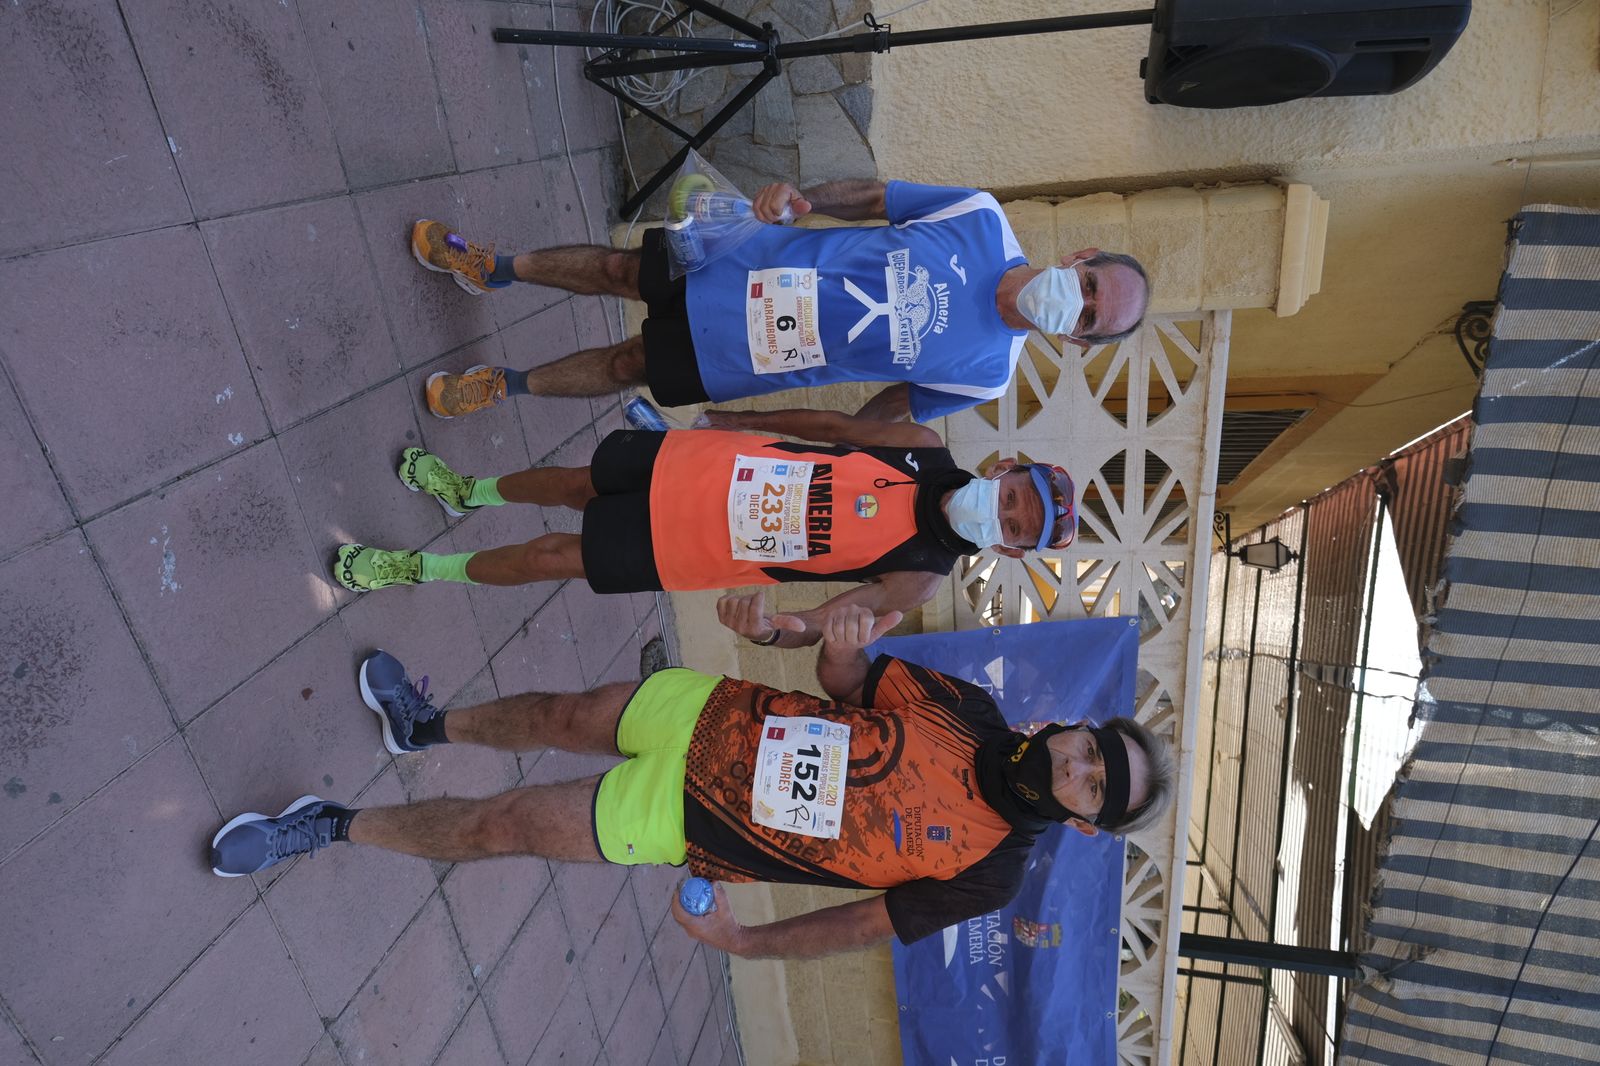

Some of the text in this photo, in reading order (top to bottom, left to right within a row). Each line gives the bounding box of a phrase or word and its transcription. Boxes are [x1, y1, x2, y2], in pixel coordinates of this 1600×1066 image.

[796, 296, 804, 320] CARRERAS
[804, 296, 813, 328] CIRCUITO
[891, 252, 912, 362] GUEPARDOS RUNNIG
[764, 298, 778, 354] BARAMBONES
[776, 315, 796, 332] 6
[797, 321, 806, 348] POPULARES
[804, 329, 816, 347] 2020
[781, 348, 798, 362] R
[749, 494, 760, 520] DIEGO
[760, 482, 786, 532] 233
[784, 484, 794, 506] CARRERAS
[792, 483, 804, 514] CIRCUITO
[783, 506, 791, 535] POPULARES
[790, 515, 800, 535] 2020
[778, 752, 794, 792] ANDRÉS
[791, 744, 822, 802] 152
[820, 744, 830, 772] CARRERAS
[816, 773, 828, 805] POPULARES
[825, 745, 842, 806] CIRCUITO 2020
[785, 804, 810, 824] R
[905, 808, 916, 856] DE ALMERÍA
[913, 806, 925, 857] DIPUTACIÓN
[968, 916, 987, 965] LMERÍA
[986, 909, 1005, 966] TACIÓN
